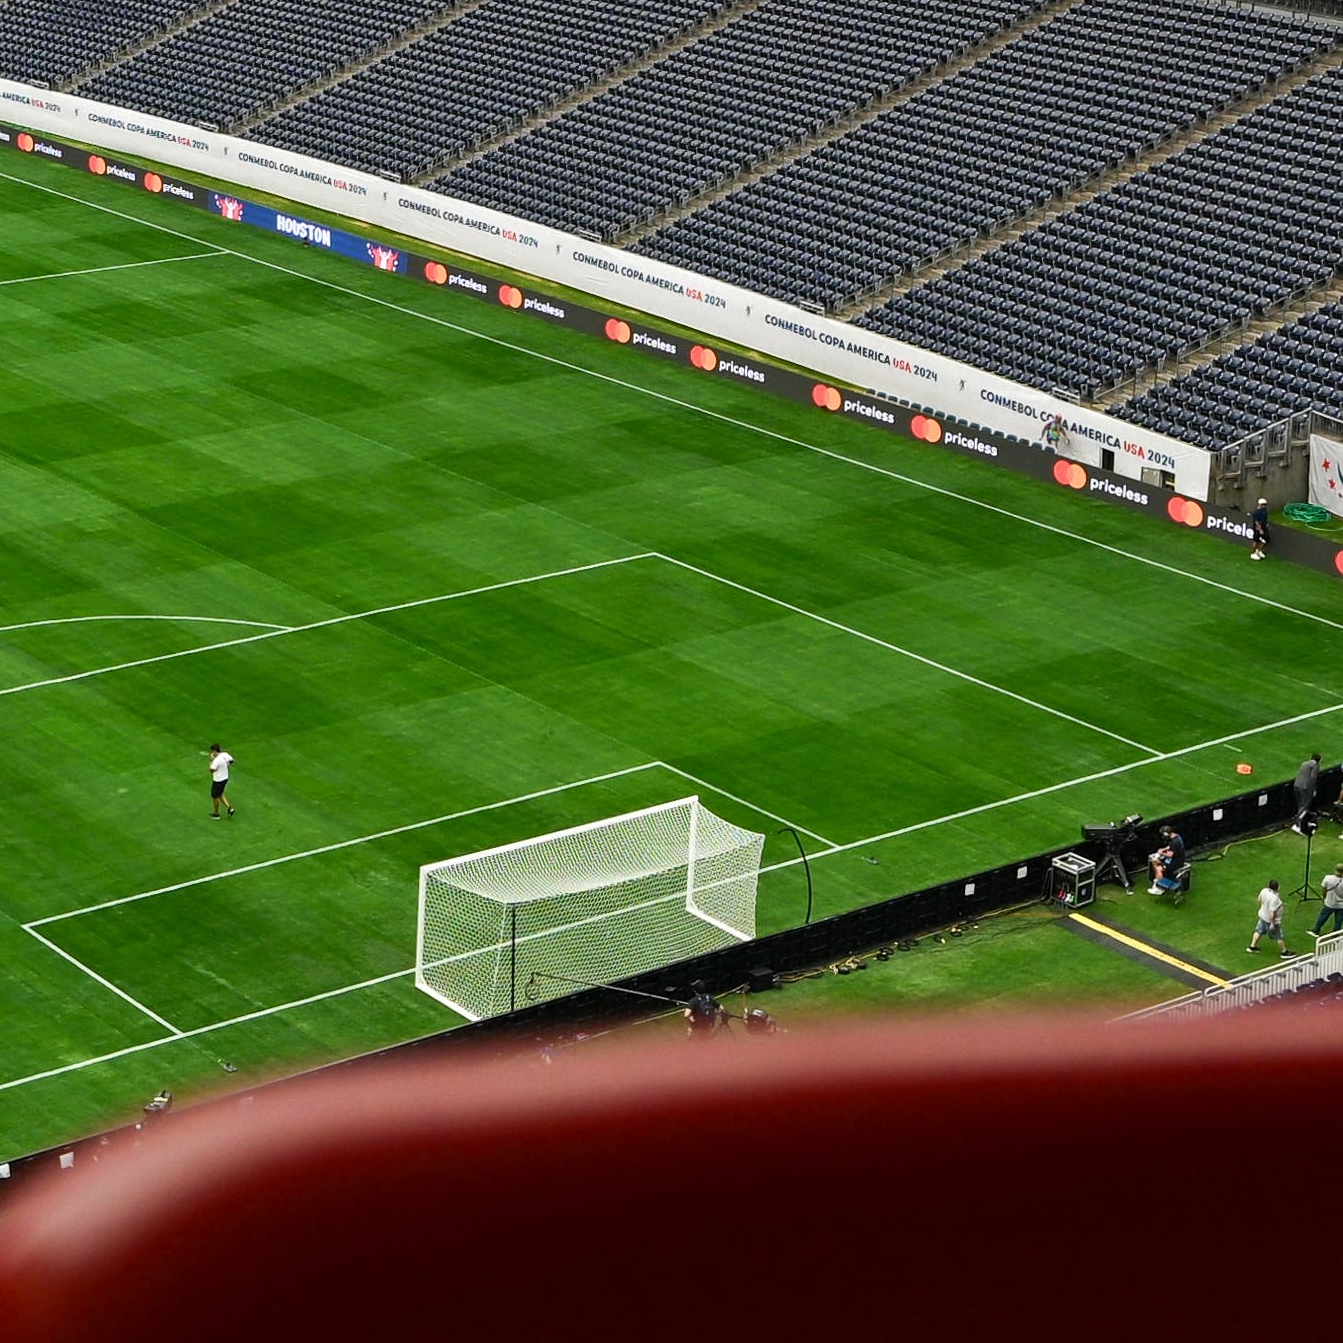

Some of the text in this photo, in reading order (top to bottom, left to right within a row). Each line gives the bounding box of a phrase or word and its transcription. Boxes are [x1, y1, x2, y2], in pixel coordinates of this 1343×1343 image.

[238, 152, 367, 196] CONMEBOL COPA AMERICA USA 2024
[163, 182, 194, 200] priceless
[276, 214, 332, 247] HOUSTON
[398, 198, 538, 248] CONMEBOL COPA AMERICA USA 2024
[449, 274, 488, 294] priceless
[572, 251, 726, 309] CONMEBOL COPA AMERICA USA 2024
[524, 297, 565, 318] priceless
[633, 332, 678, 355] priceless
[764, 314, 938, 382] CONMEBOL COPA AMERICA USA 2024
[719, 359, 765, 383] priceless
[844, 399, 895, 424] priceless
[980, 389, 1037, 419] CONMEBOL
[1070, 424, 1121, 450] AMERICA
[1122, 440, 1146, 459] USA
[1147, 449, 1175, 469] 2024
[944, 431, 998, 457] priceless
[1089, 477, 1149, 506] priceless
[1207, 515, 1254, 540] pricele
